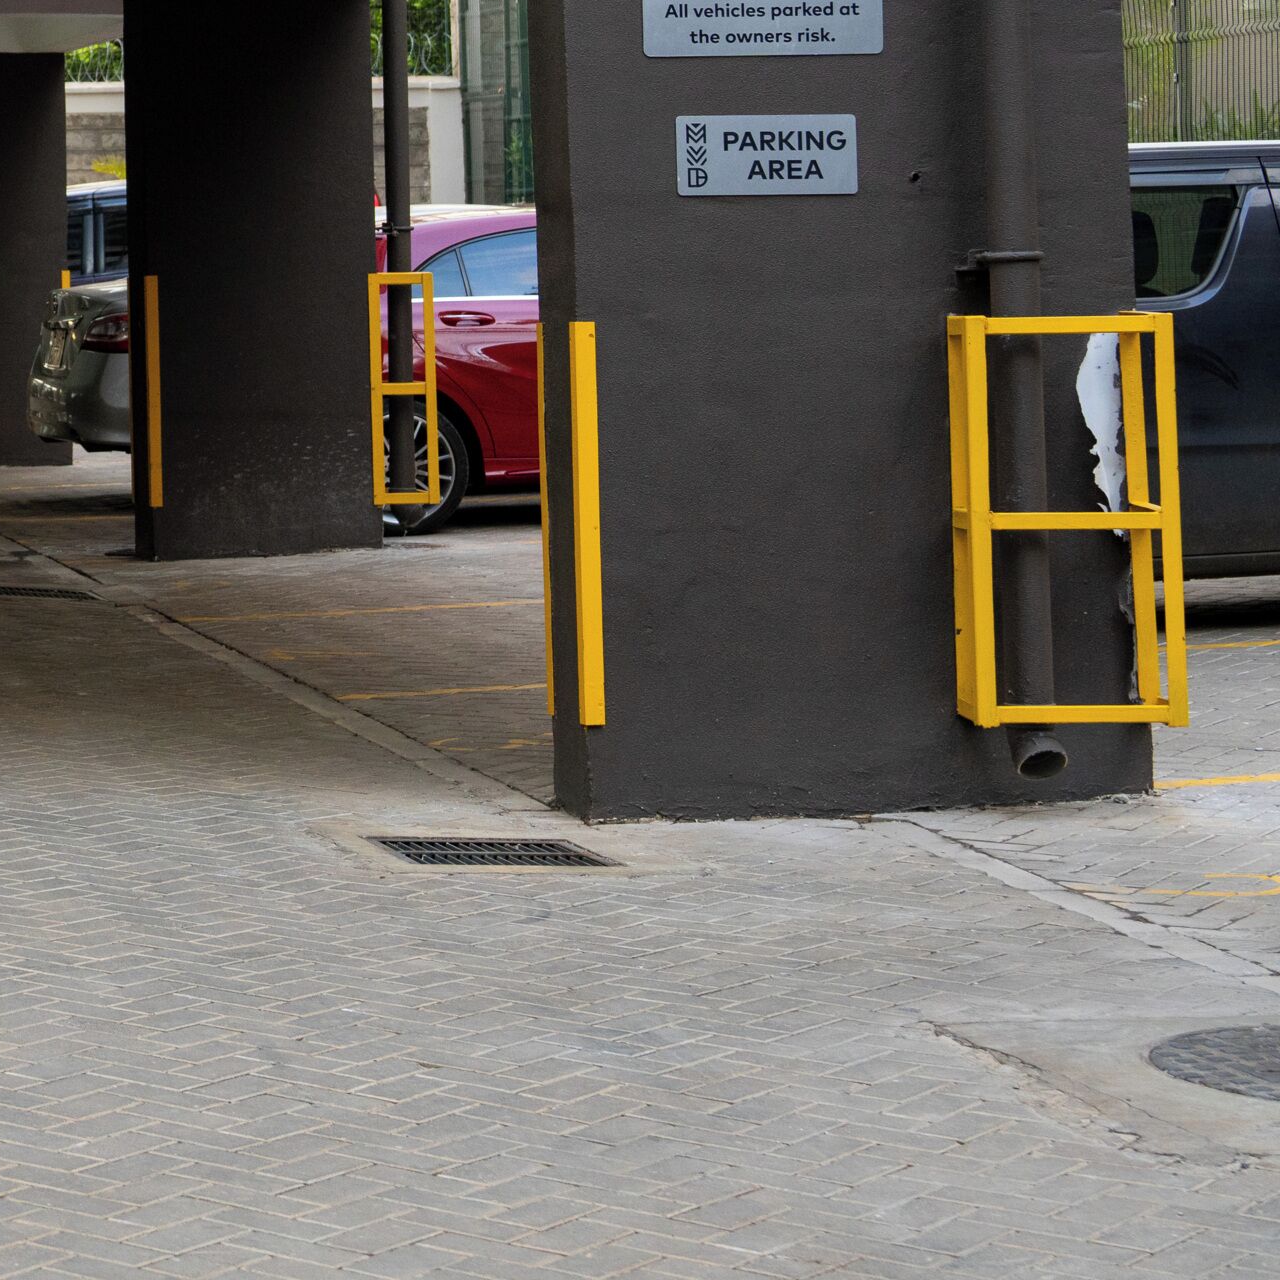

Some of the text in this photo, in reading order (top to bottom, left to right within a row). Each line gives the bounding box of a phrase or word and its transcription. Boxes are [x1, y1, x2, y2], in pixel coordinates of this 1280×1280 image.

[664, 1, 860, 21] All vehicles parked at
[689, 27, 836, 44] the owners risk.
[723, 130, 847, 152] PARKING
[747, 159, 824, 180] AREA
